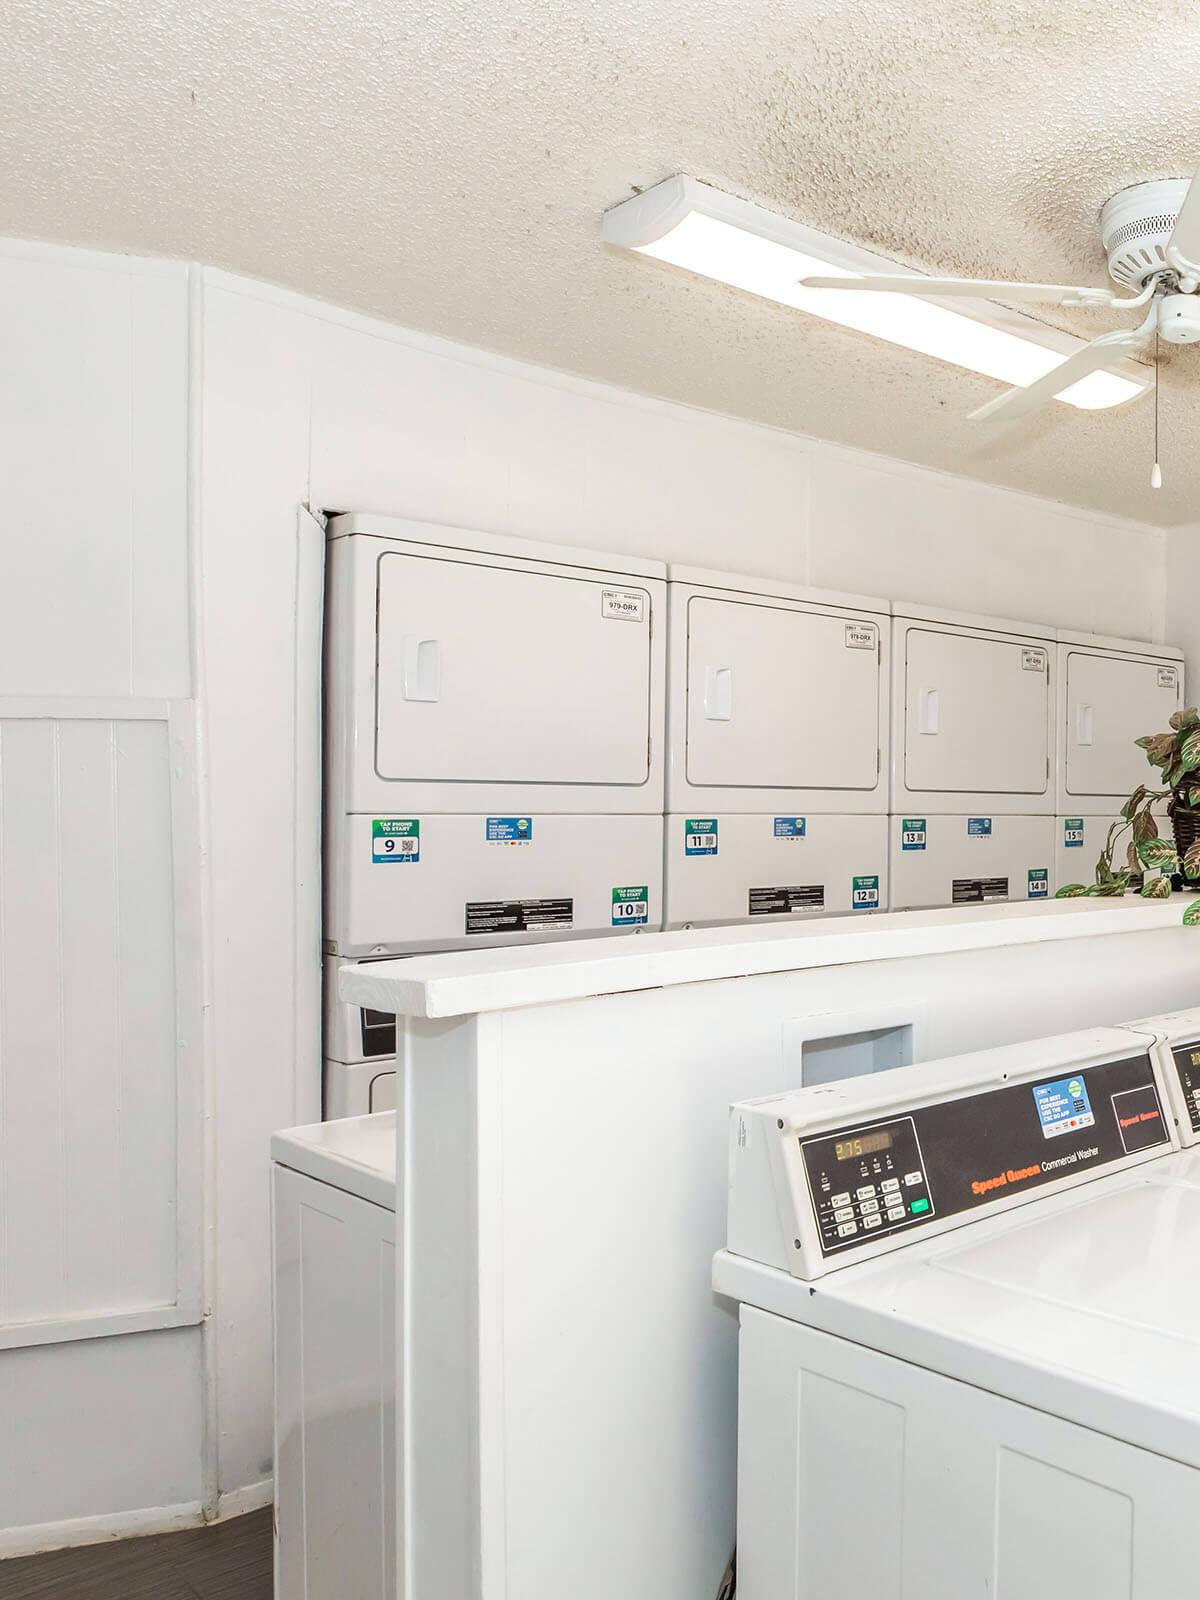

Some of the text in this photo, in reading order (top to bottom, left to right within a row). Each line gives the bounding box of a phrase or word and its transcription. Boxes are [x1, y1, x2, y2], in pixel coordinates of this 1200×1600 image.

[692, 835, 702, 846] 11
[906, 833, 915, 842] 13
[1068, 831, 1076, 840] 15
[384, 839, 395, 852] 9
[857, 891, 867, 900] 12
[618, 904, 633, 916] 10
[971, 1146, 1099, 1195] Speed Queen Commercial Washer
